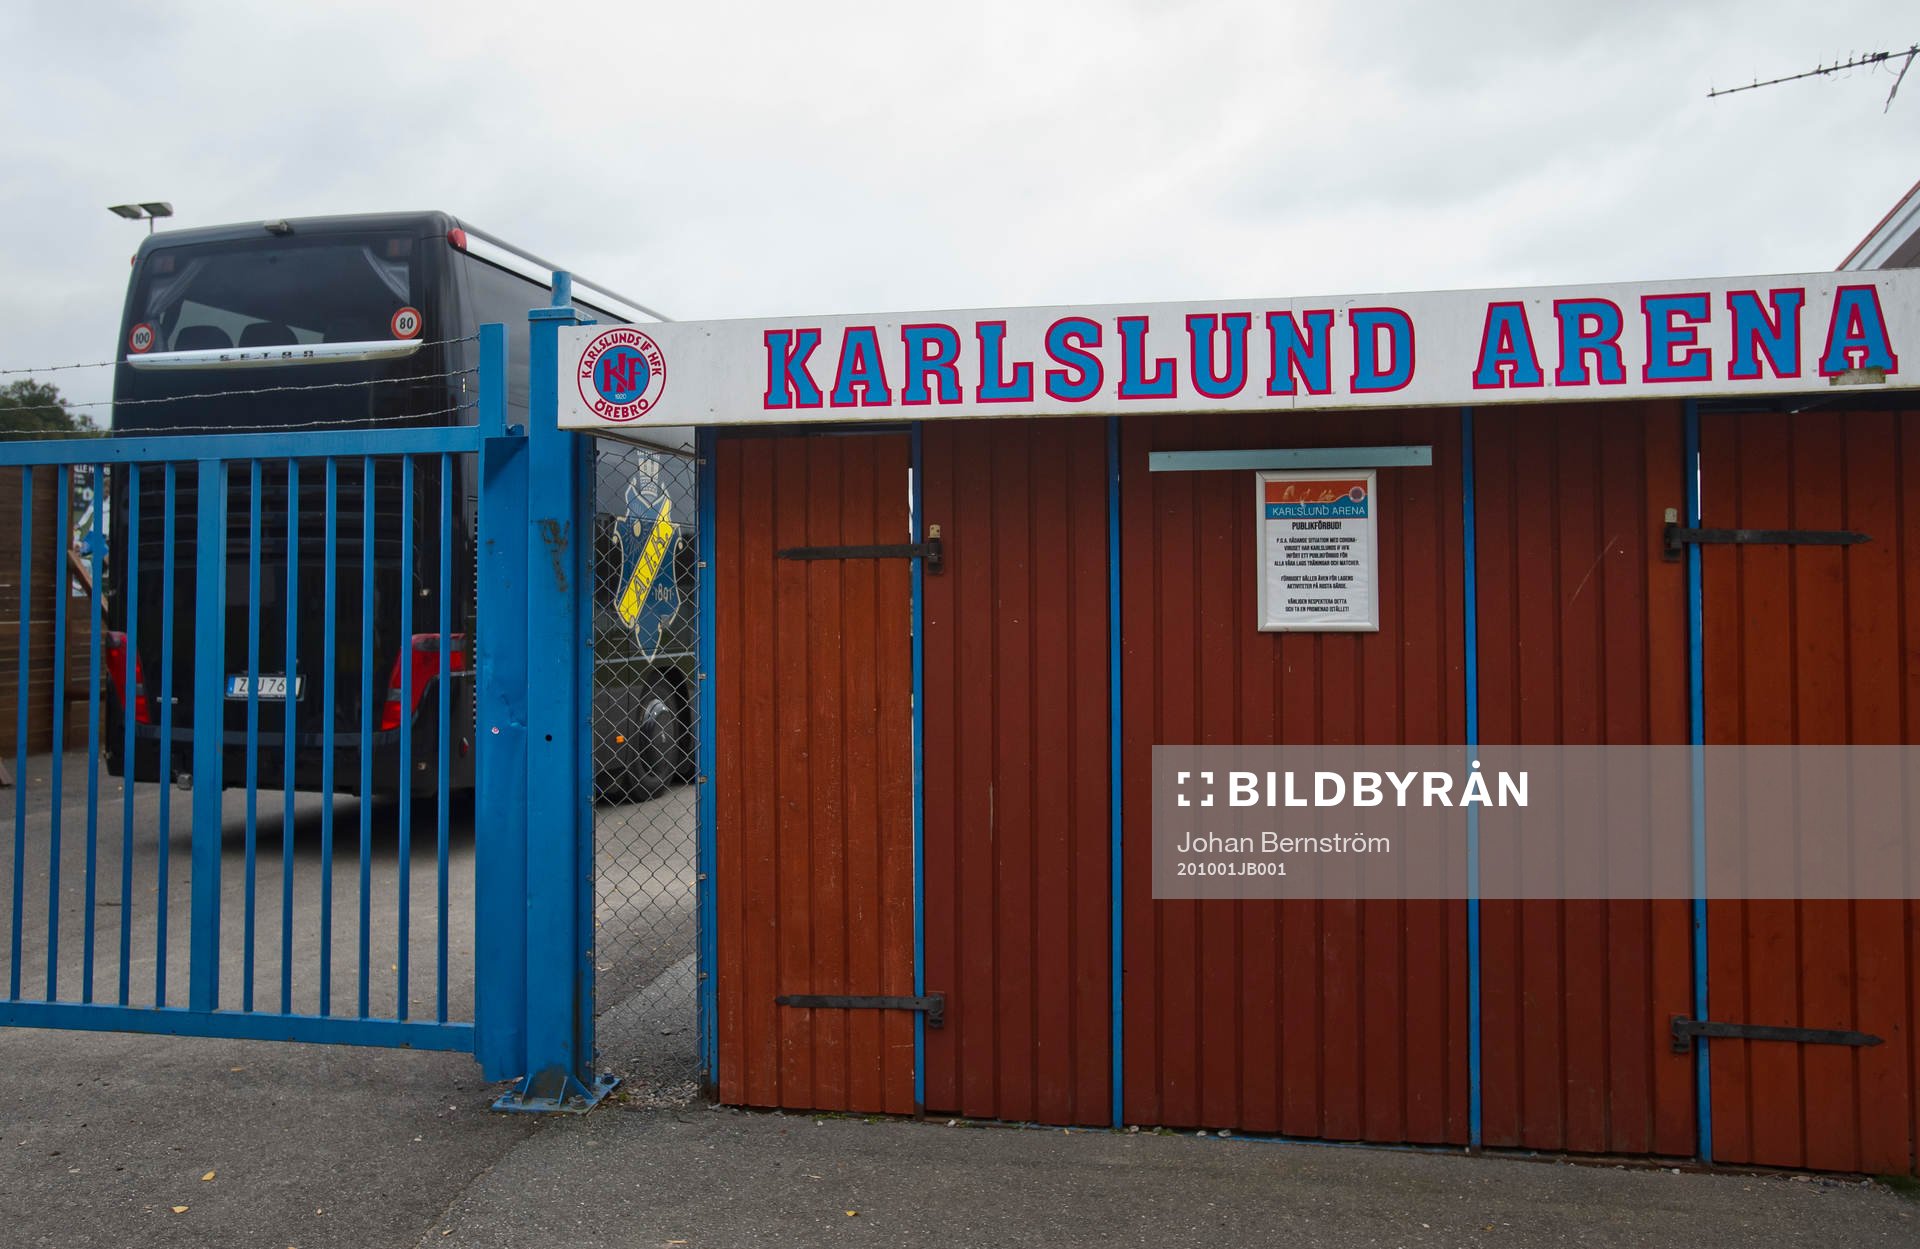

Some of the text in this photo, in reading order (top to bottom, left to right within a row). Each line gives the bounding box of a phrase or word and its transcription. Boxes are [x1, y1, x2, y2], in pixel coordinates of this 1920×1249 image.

[399, 317, 414, 331] 80
[134, 332, 150, 345] 100
[763, 284, 1899, 410] KARLSLUND ARENA
[581, 332, 663, 379] KARLSLUNDS IF HFK
[594, 398, 649, 419] ÖREBRO
[1272, 504, 1366, 516] KARLSLUND ARENA
[1291, 520, 1342, 531] PUBLIKFÖRBUD!
[239, 678, 265, 693] ZU
